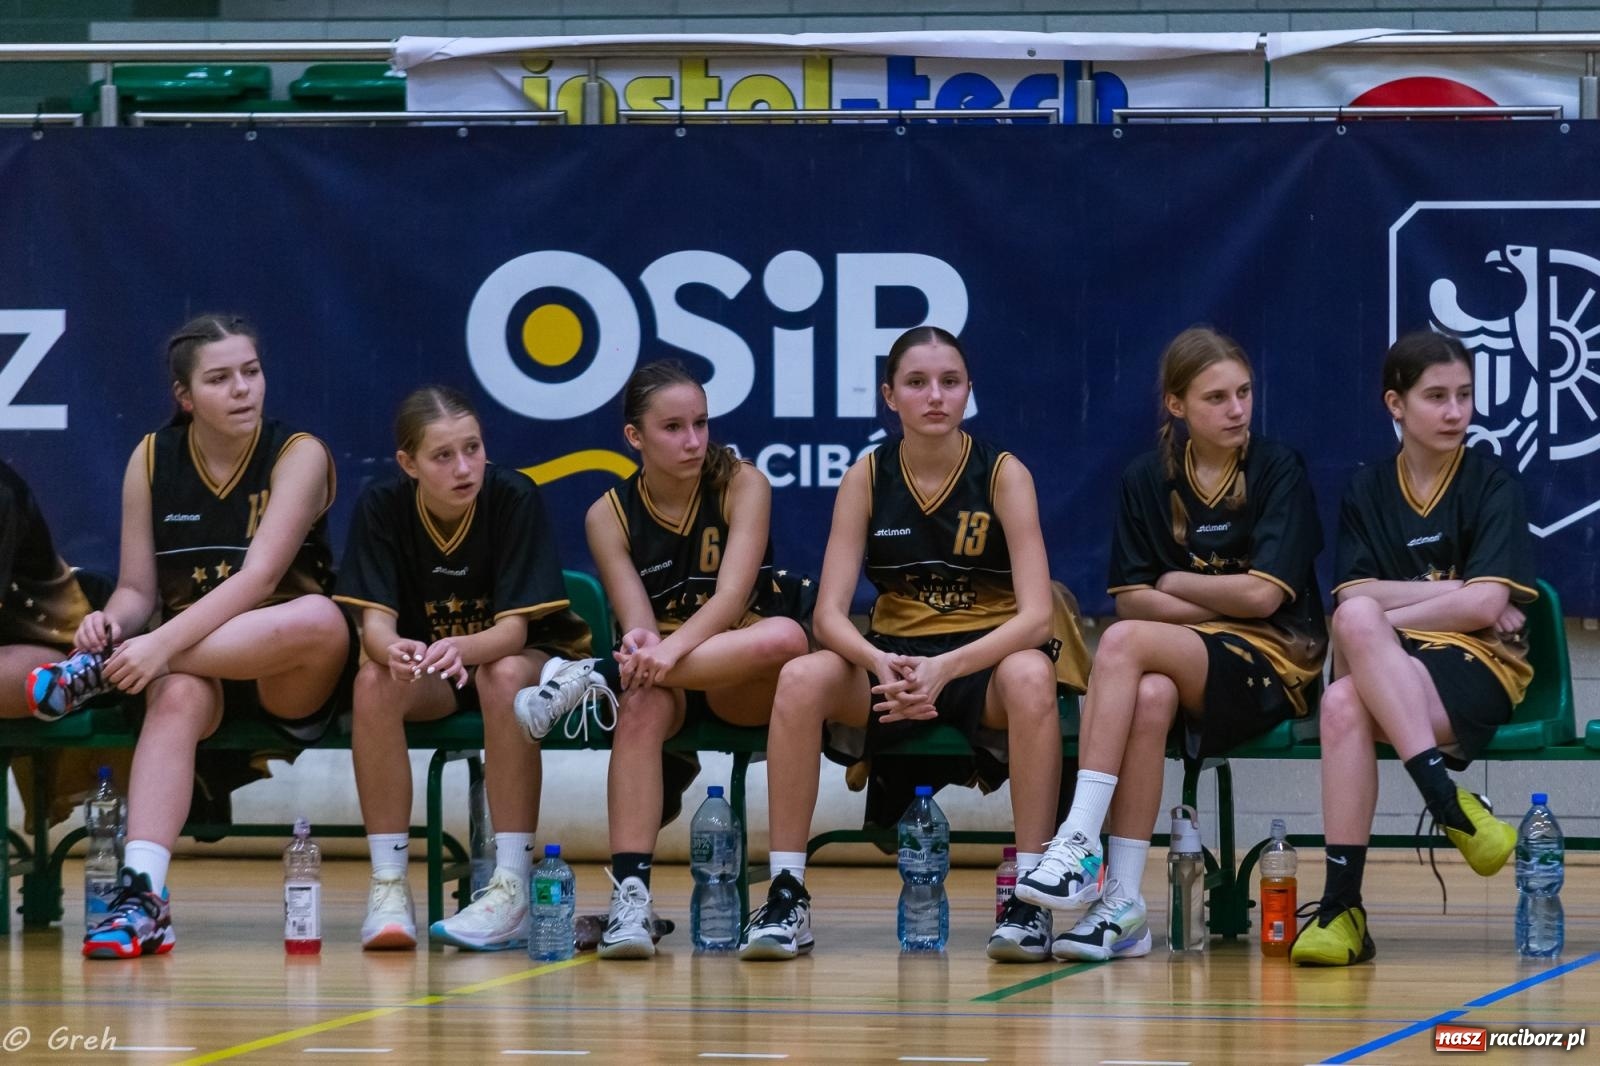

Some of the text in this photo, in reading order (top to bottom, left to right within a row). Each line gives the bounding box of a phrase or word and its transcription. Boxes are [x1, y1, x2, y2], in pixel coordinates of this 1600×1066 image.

[466, 250, 979, 420] OSiR
[700, 526, 720, 573] 6
[953, 510, 990, 556] 13
